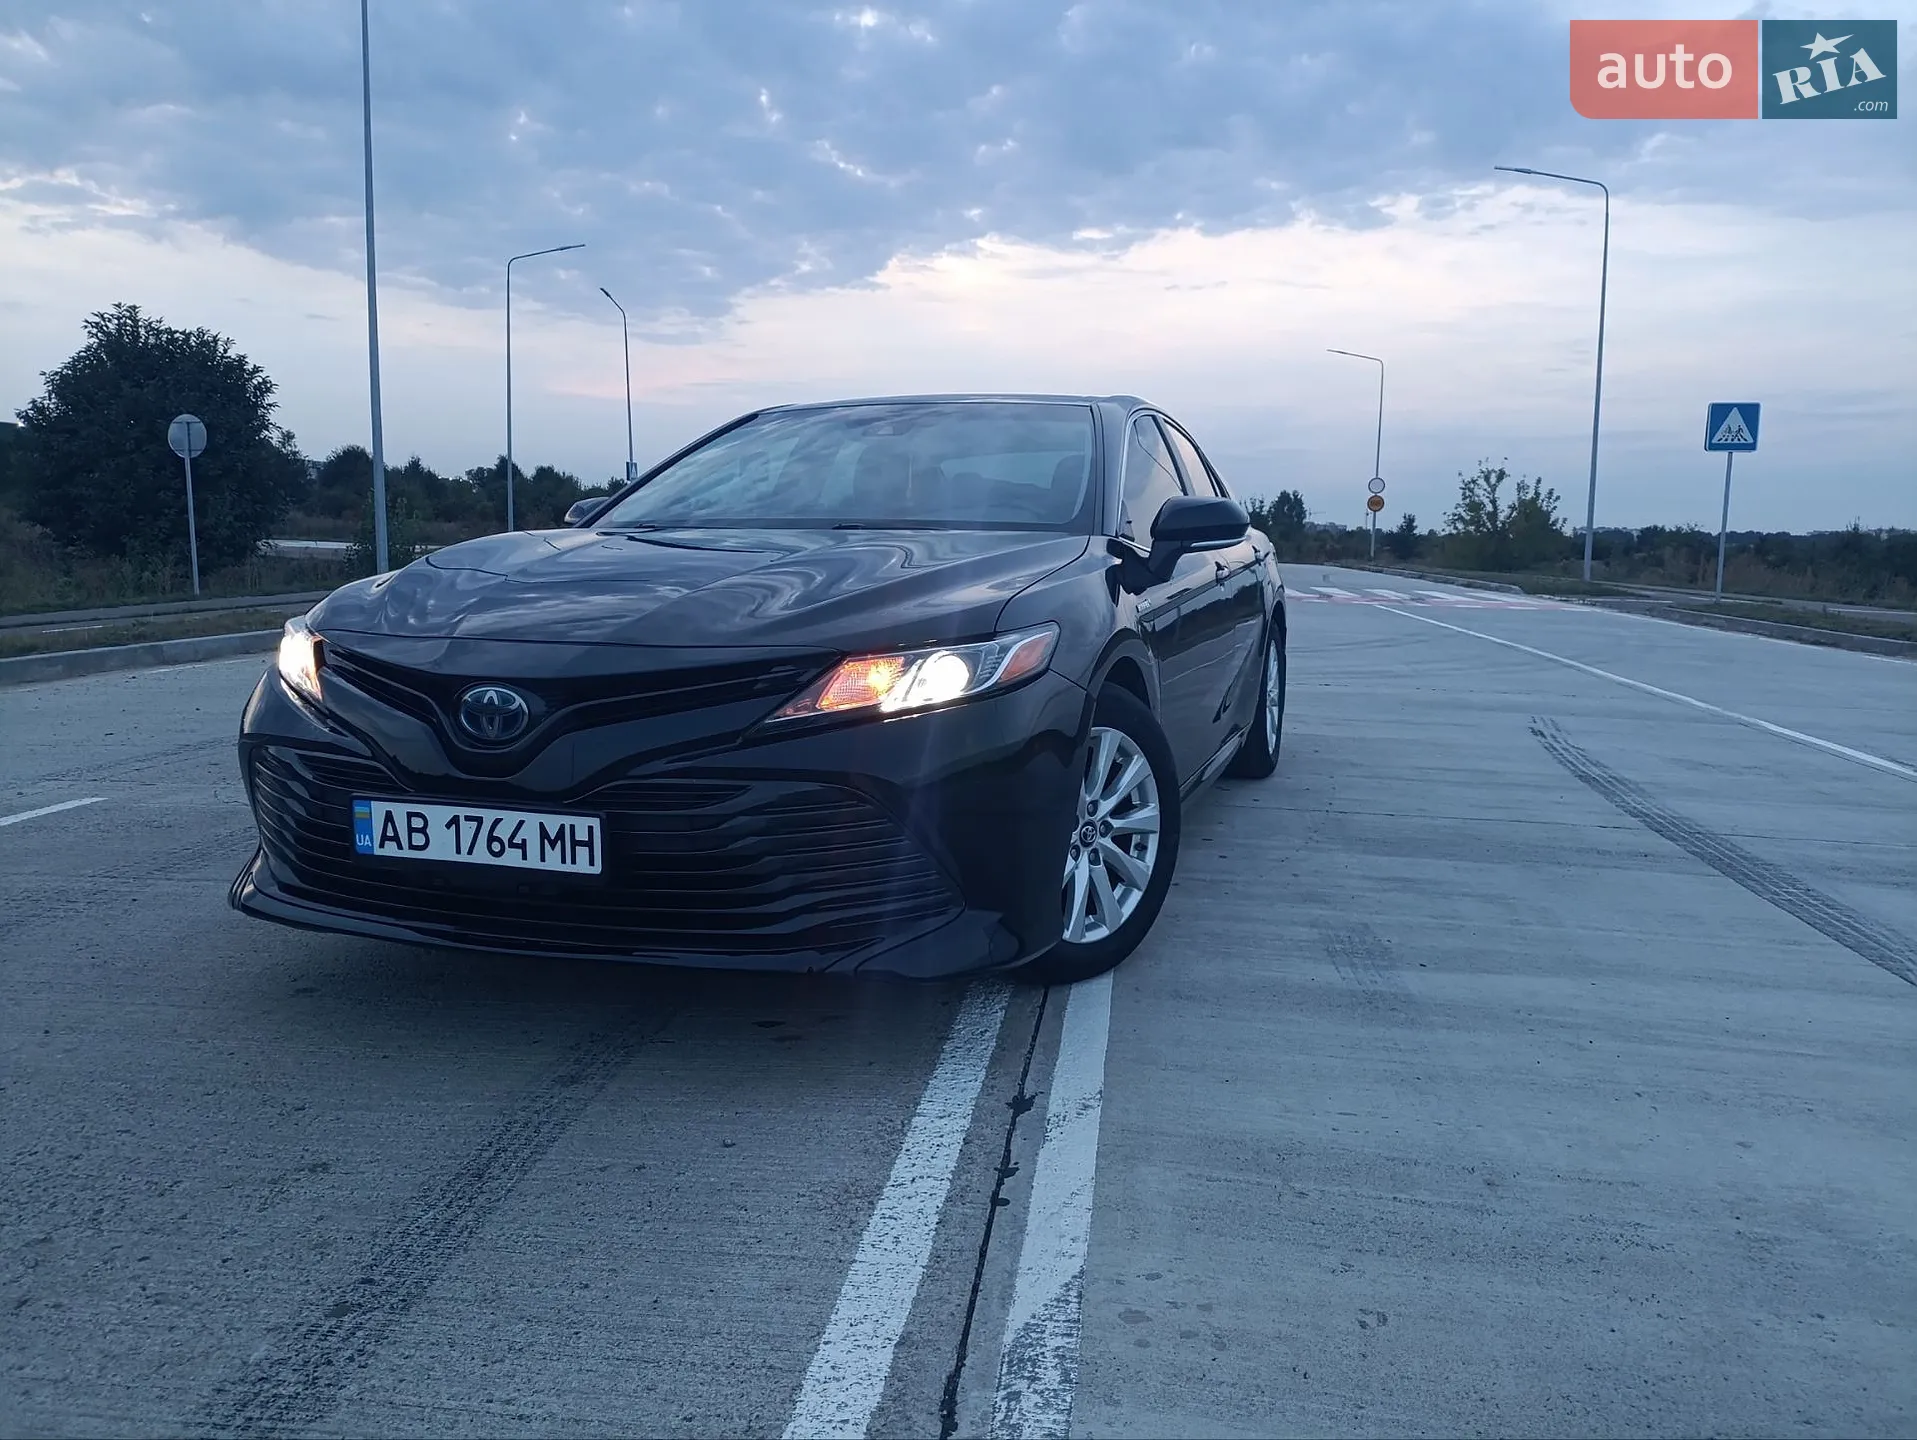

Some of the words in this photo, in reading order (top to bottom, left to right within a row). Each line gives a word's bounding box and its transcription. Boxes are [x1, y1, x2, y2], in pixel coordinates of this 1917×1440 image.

[356, 833, 372, 847] UA
[378, 809, 431, 851] AB
[444, 814, 528, 861] 1764
[538, 821, 596, 867] MH
